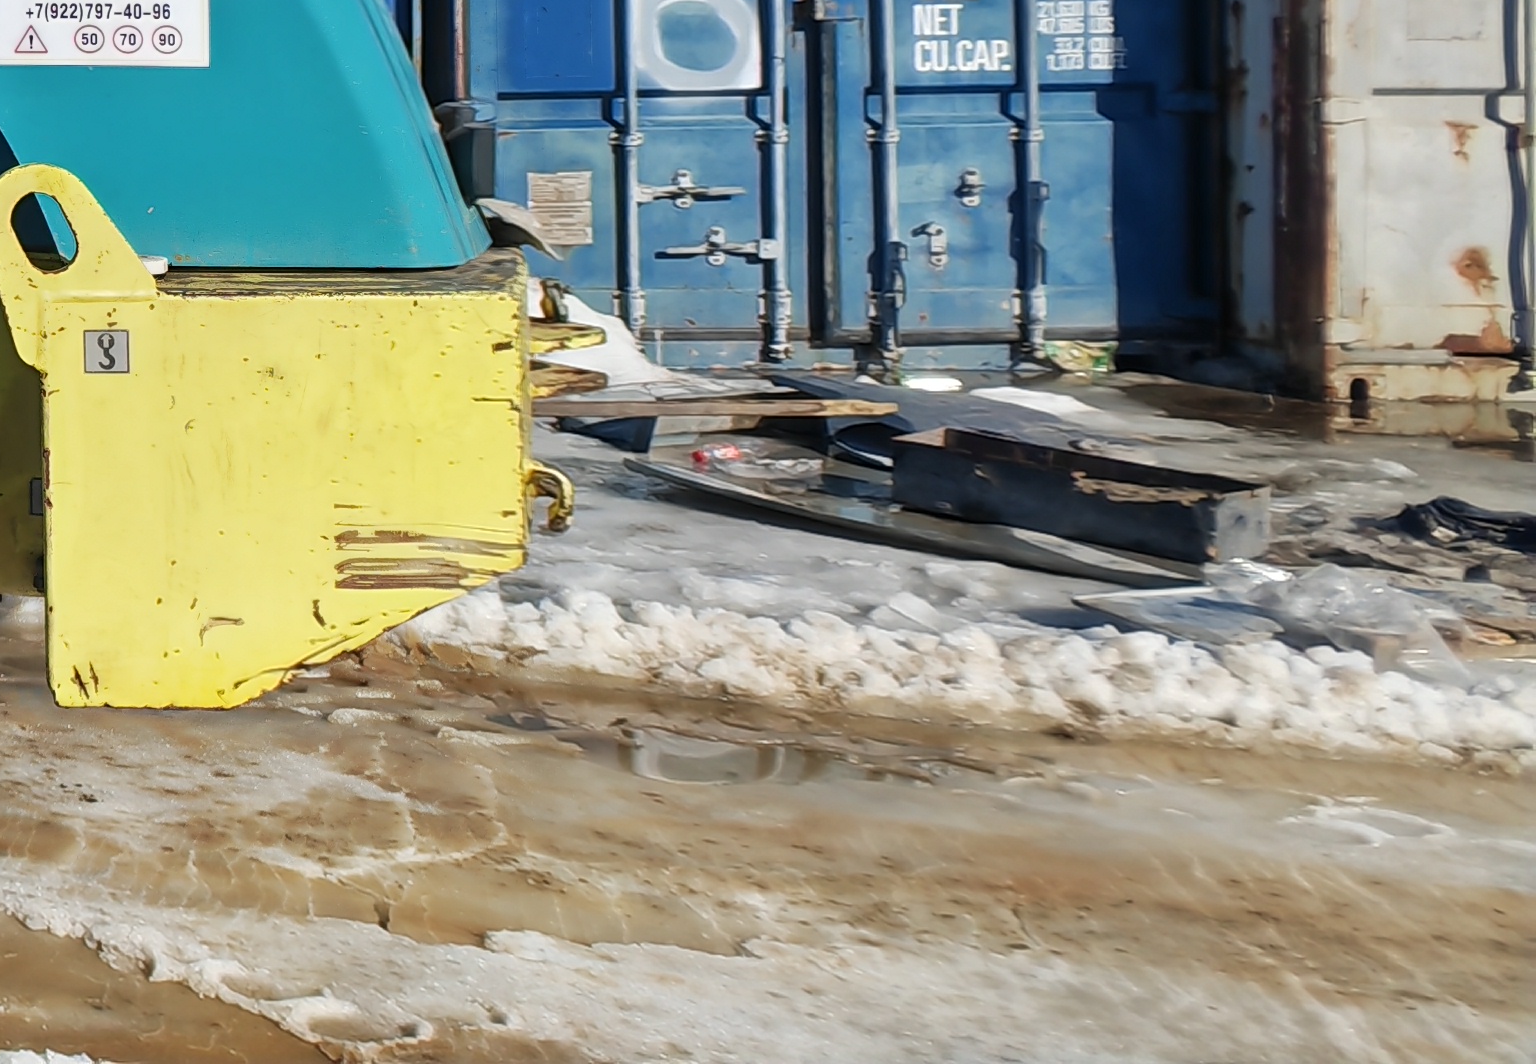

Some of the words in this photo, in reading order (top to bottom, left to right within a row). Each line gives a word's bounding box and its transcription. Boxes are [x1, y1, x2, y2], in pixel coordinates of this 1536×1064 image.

[26, 3, 171, 22] +7(922)797-40-96
[913, 4, 964, 35] NET
[81, 33, 98, 46] 50
[120, 34, 137, 46] 70
[159, 34, 176, 47] 90
[914, 39, 1012, 72] CU.CAP.
